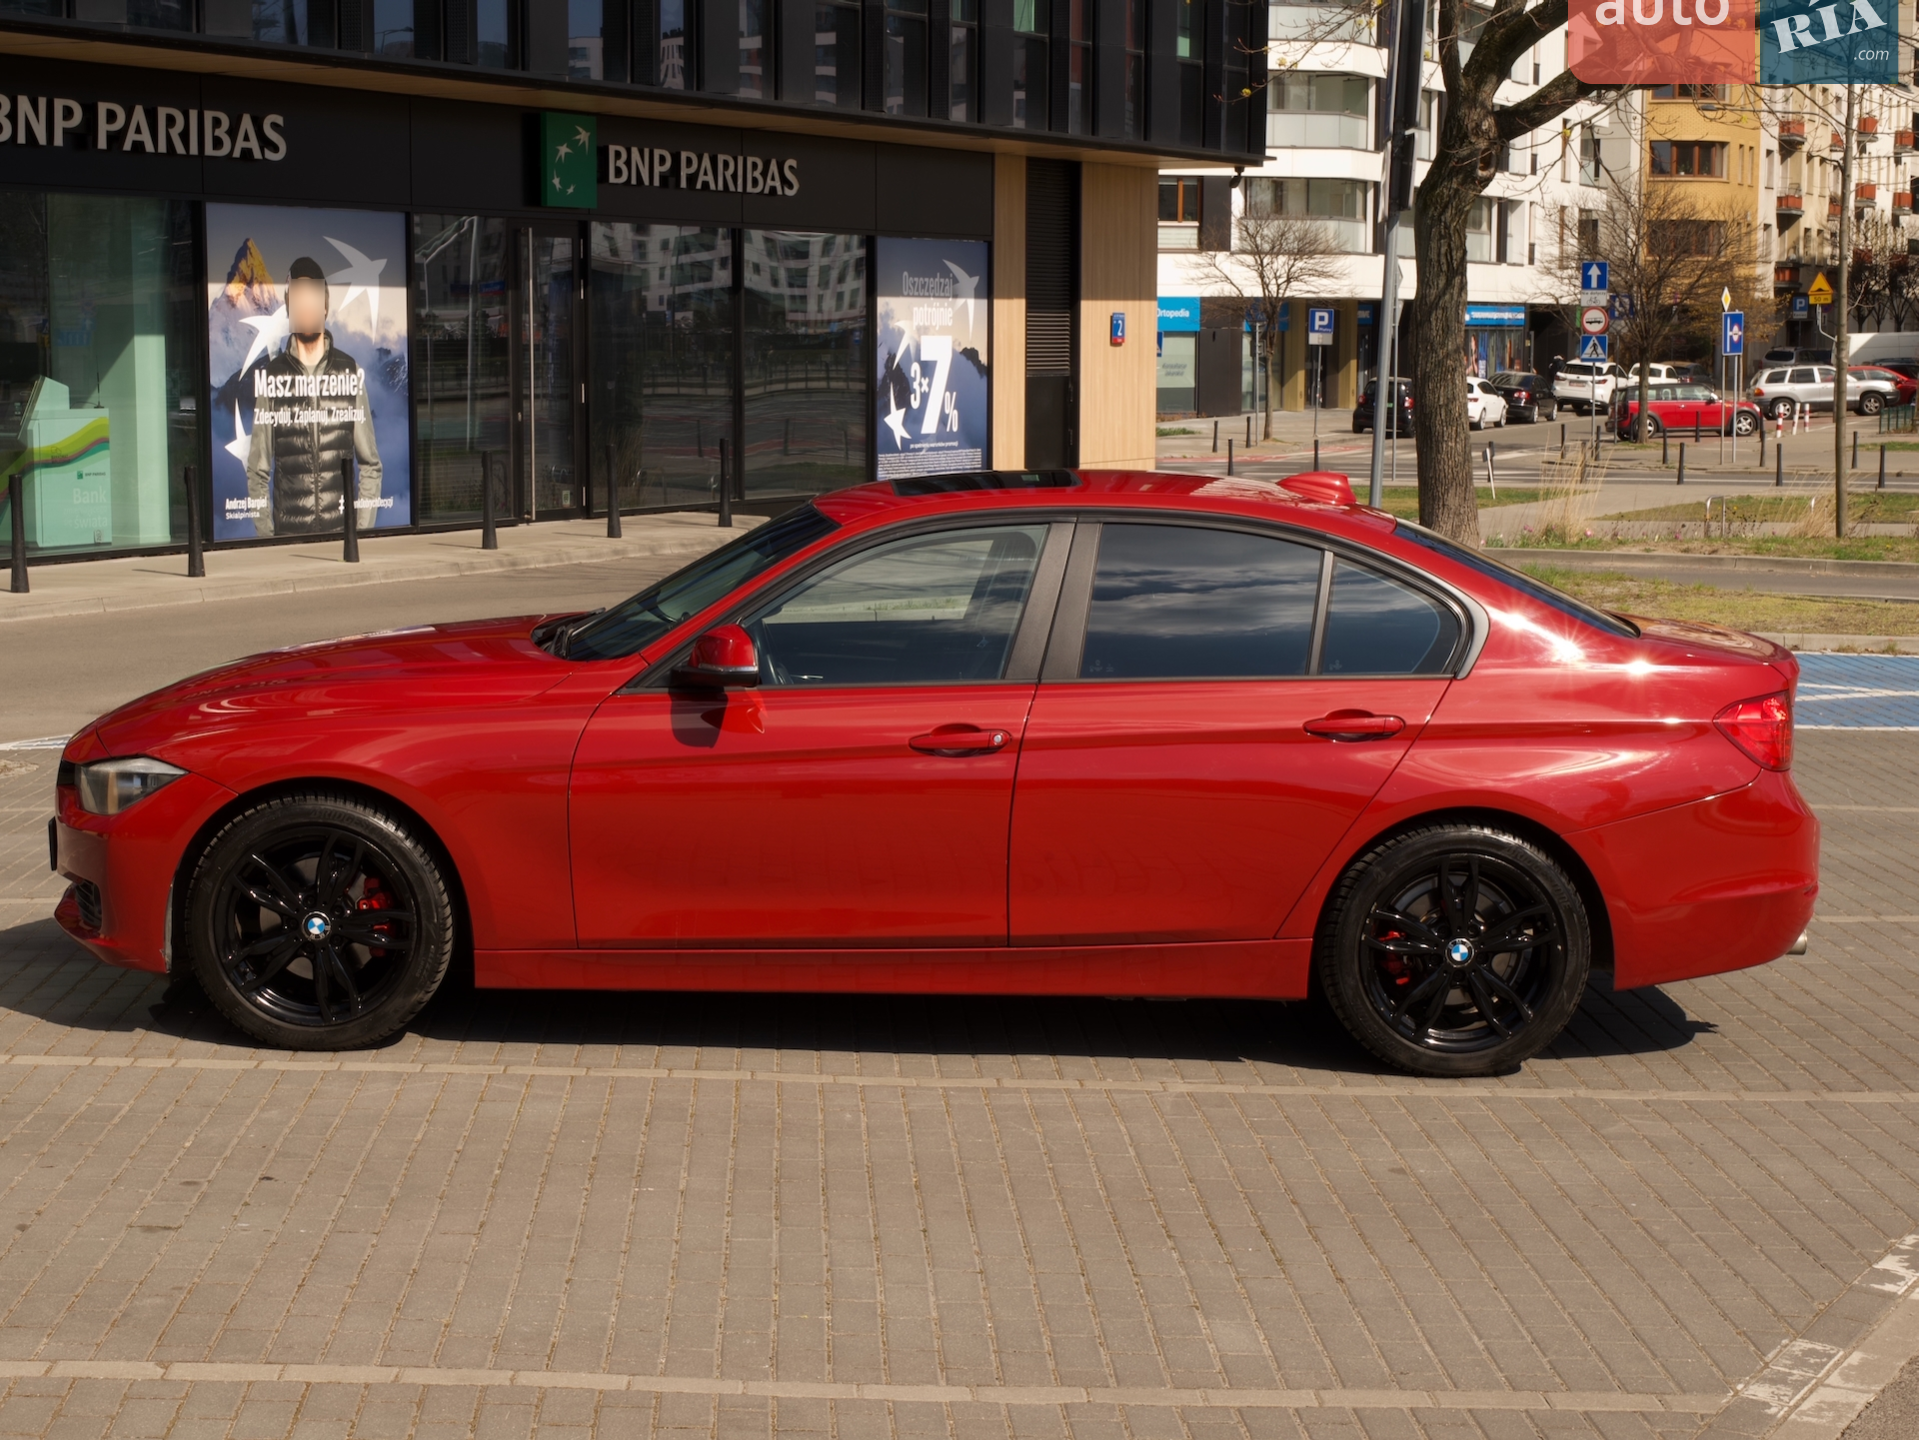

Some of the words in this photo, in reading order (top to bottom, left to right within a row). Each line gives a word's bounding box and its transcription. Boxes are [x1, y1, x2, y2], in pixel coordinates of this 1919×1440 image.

[97, 101, 287, 161] PARIBAS
[608, 144, 672, 187] BNP
[680, 150, 800, 197] PARIBAS
[902, 271, 953, 301] Oszczędzaj
[1796, 298, 1806, 310] P
[913, 303, 953, 330] potrójnie
[1314, 311, 1329, 331] P
[1117, 320, 1123, 336] 2
[254, 369, 292, 398] Masz
[295, 368, 365, 397] marzenie?
[253, 408, 293, 427] Zdecyduj.
[294, 407, 331, 426] Zaplanuj.
[331, 405, 366, 424] Zrealizuj.
[73, 485, 107, 505] Bank
[225, 497, 247, 511] Andrzej
